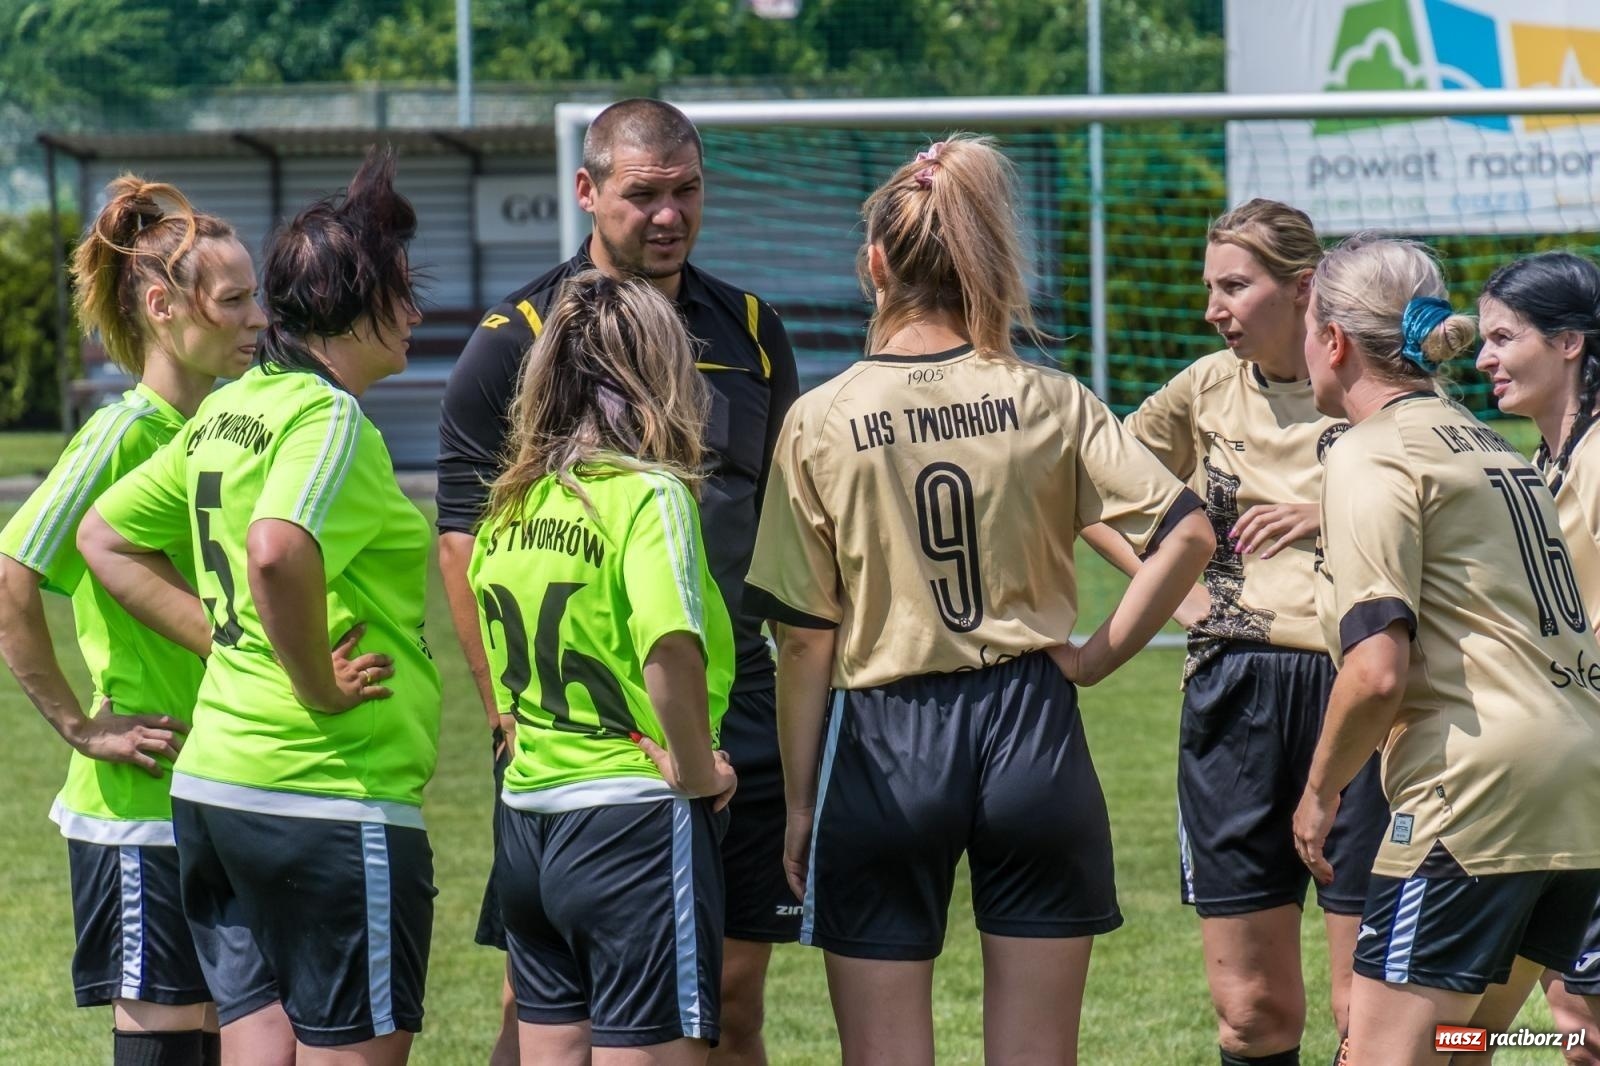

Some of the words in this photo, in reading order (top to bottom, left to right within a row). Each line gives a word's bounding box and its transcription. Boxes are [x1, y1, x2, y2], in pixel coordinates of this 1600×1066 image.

[1308, 149, 1439, 188] powiat
[908, 368, 944, 385] 1905
[850, 410, 895, 452] LKS
[903, 393, 1019, 443] TWORKÓW
[1432, 424, 1474, 454] LKS
[195, 471, 245, 651] 5
[507, 517, 605, 569] TWORKÓW
[914, 461, 984, 633] 9
[1483, 467, 1586, 637] 16
